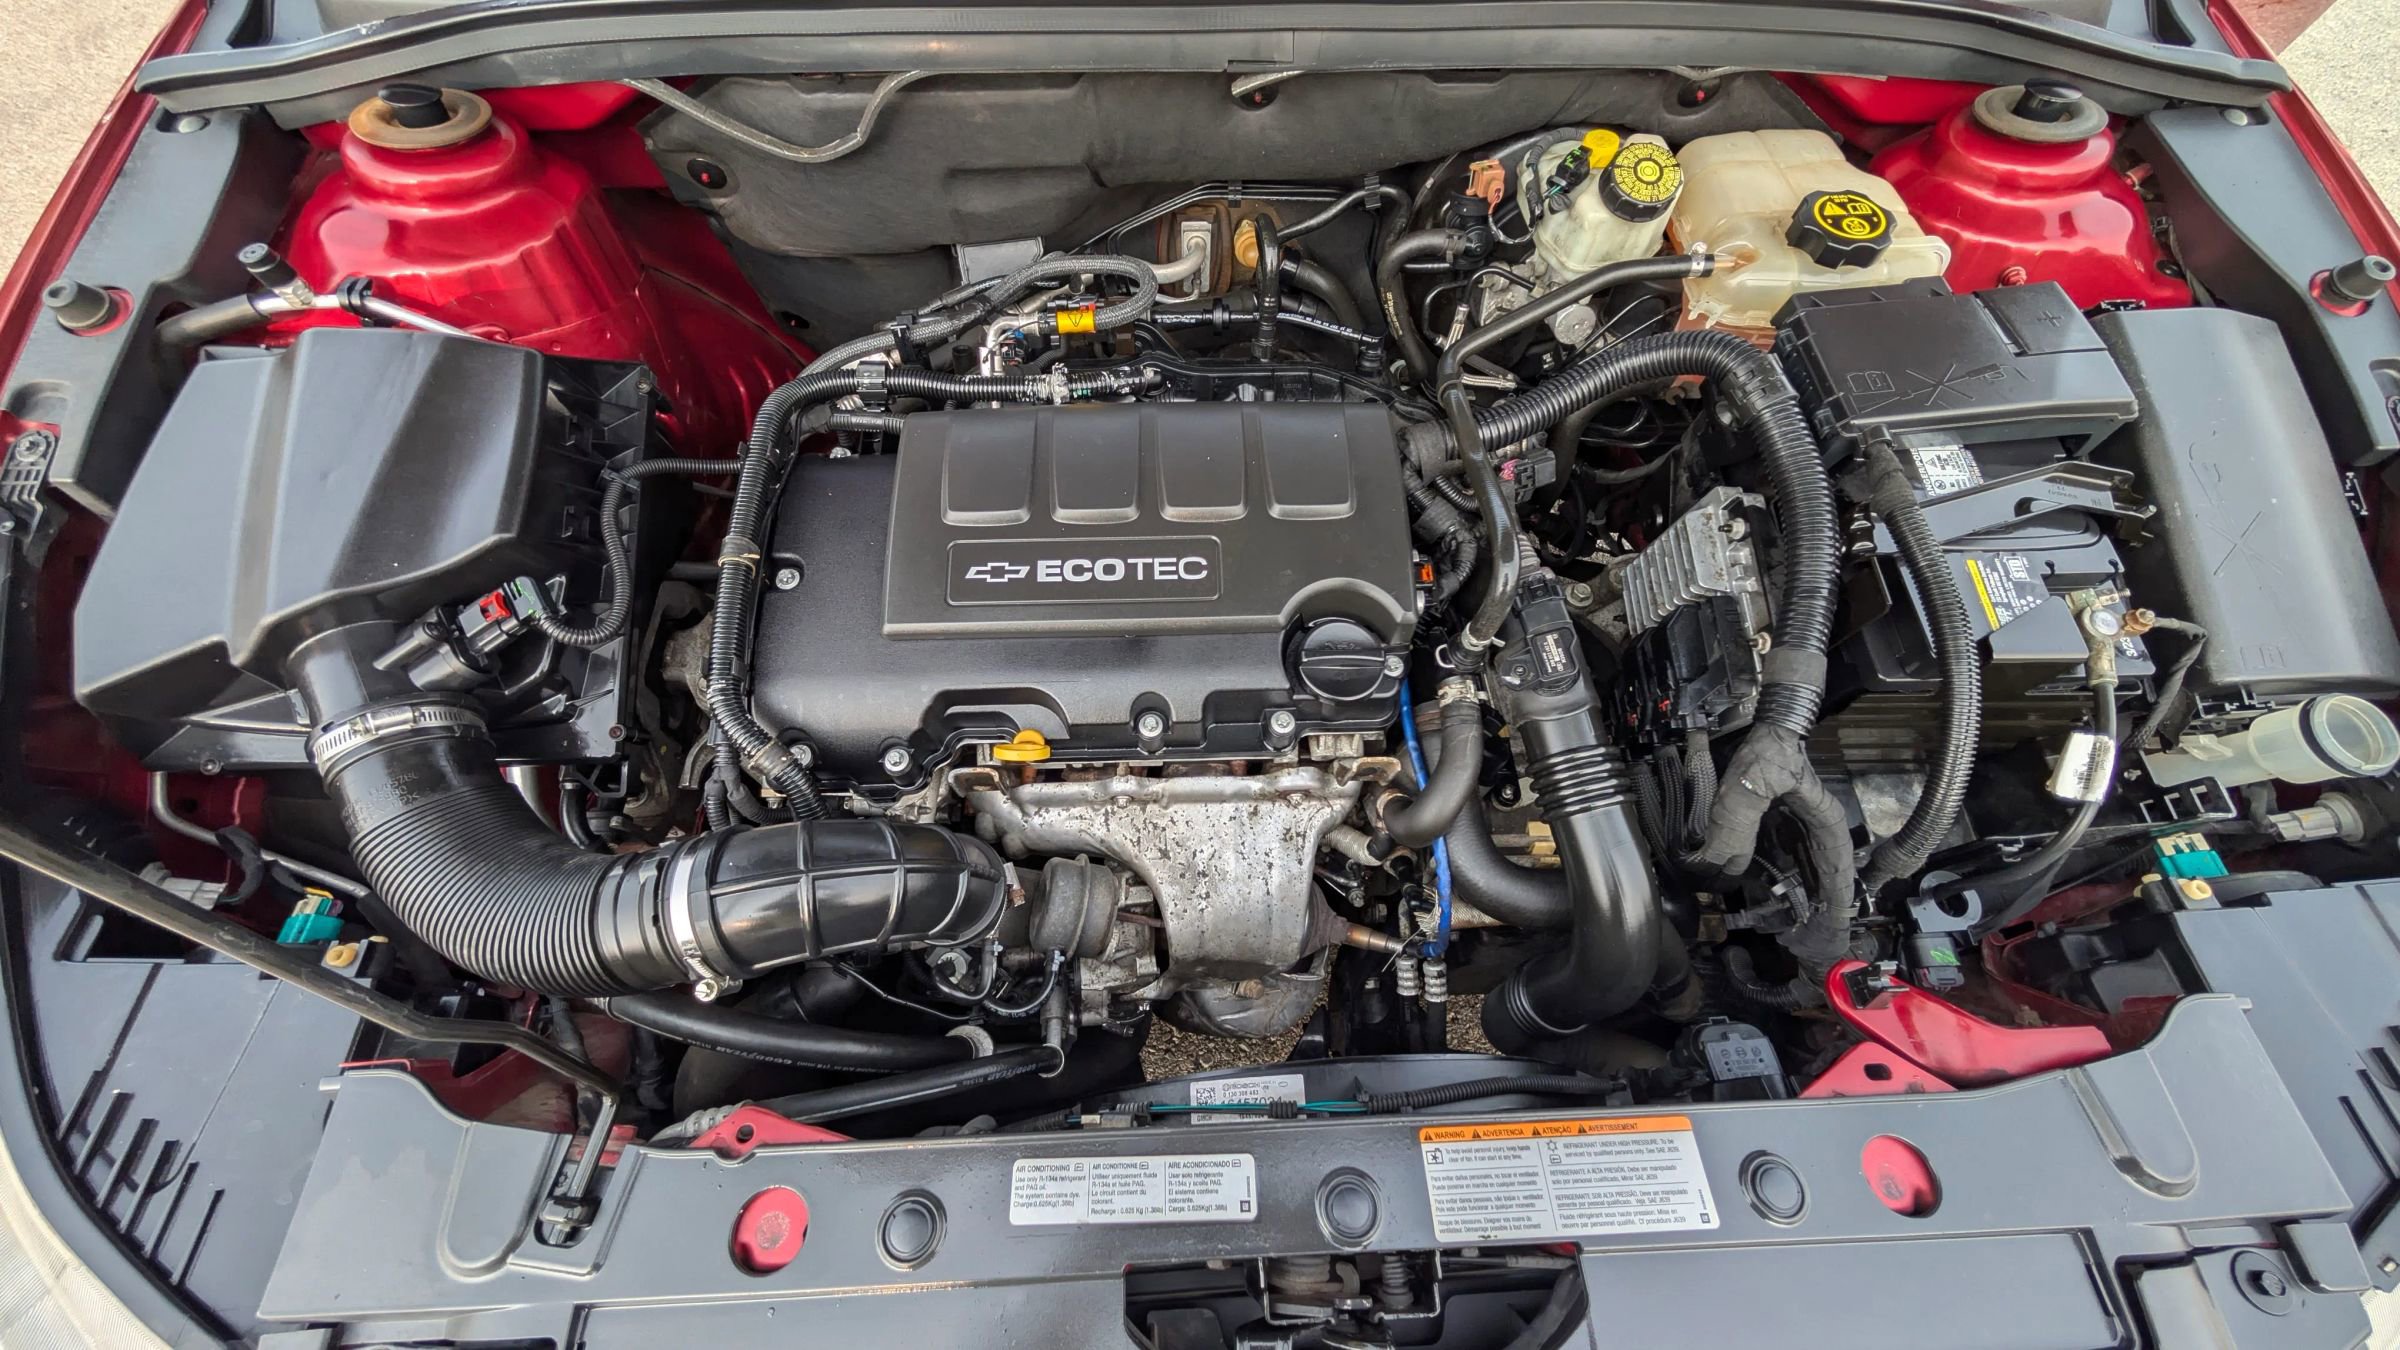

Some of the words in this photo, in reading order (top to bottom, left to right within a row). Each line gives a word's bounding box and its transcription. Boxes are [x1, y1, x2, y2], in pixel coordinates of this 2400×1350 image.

[1036, 556, 1208, 582] ECOTEC
[714, 1044, 794, 1066] GOODYEAR
[1434, 1130, 1465, 1139] WARNING
[1482, 1128, 1524, 1137] ADVERTENCIA
[1587, 1122, 1638, 1132] AVERTISSEMENT
